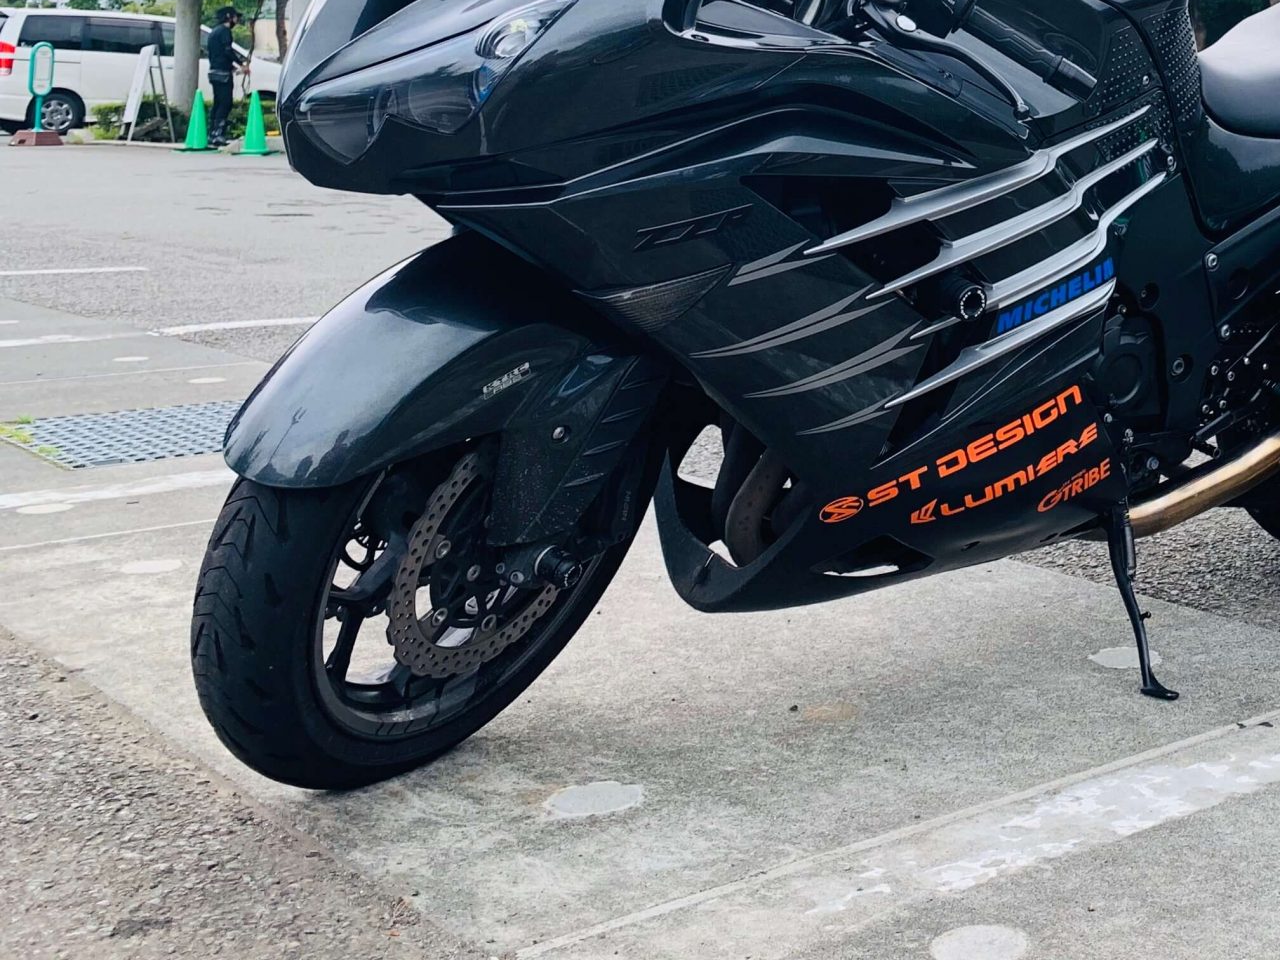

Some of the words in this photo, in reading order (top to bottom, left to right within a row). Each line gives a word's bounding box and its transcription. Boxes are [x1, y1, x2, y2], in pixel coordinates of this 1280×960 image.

[997, 257, 1115, 334] MICHELIN
[867, 465, 928, 507] ST
[936, 384, 1084, 479] DESIGN
[940, 422, 1099, 516] LUMIERE
